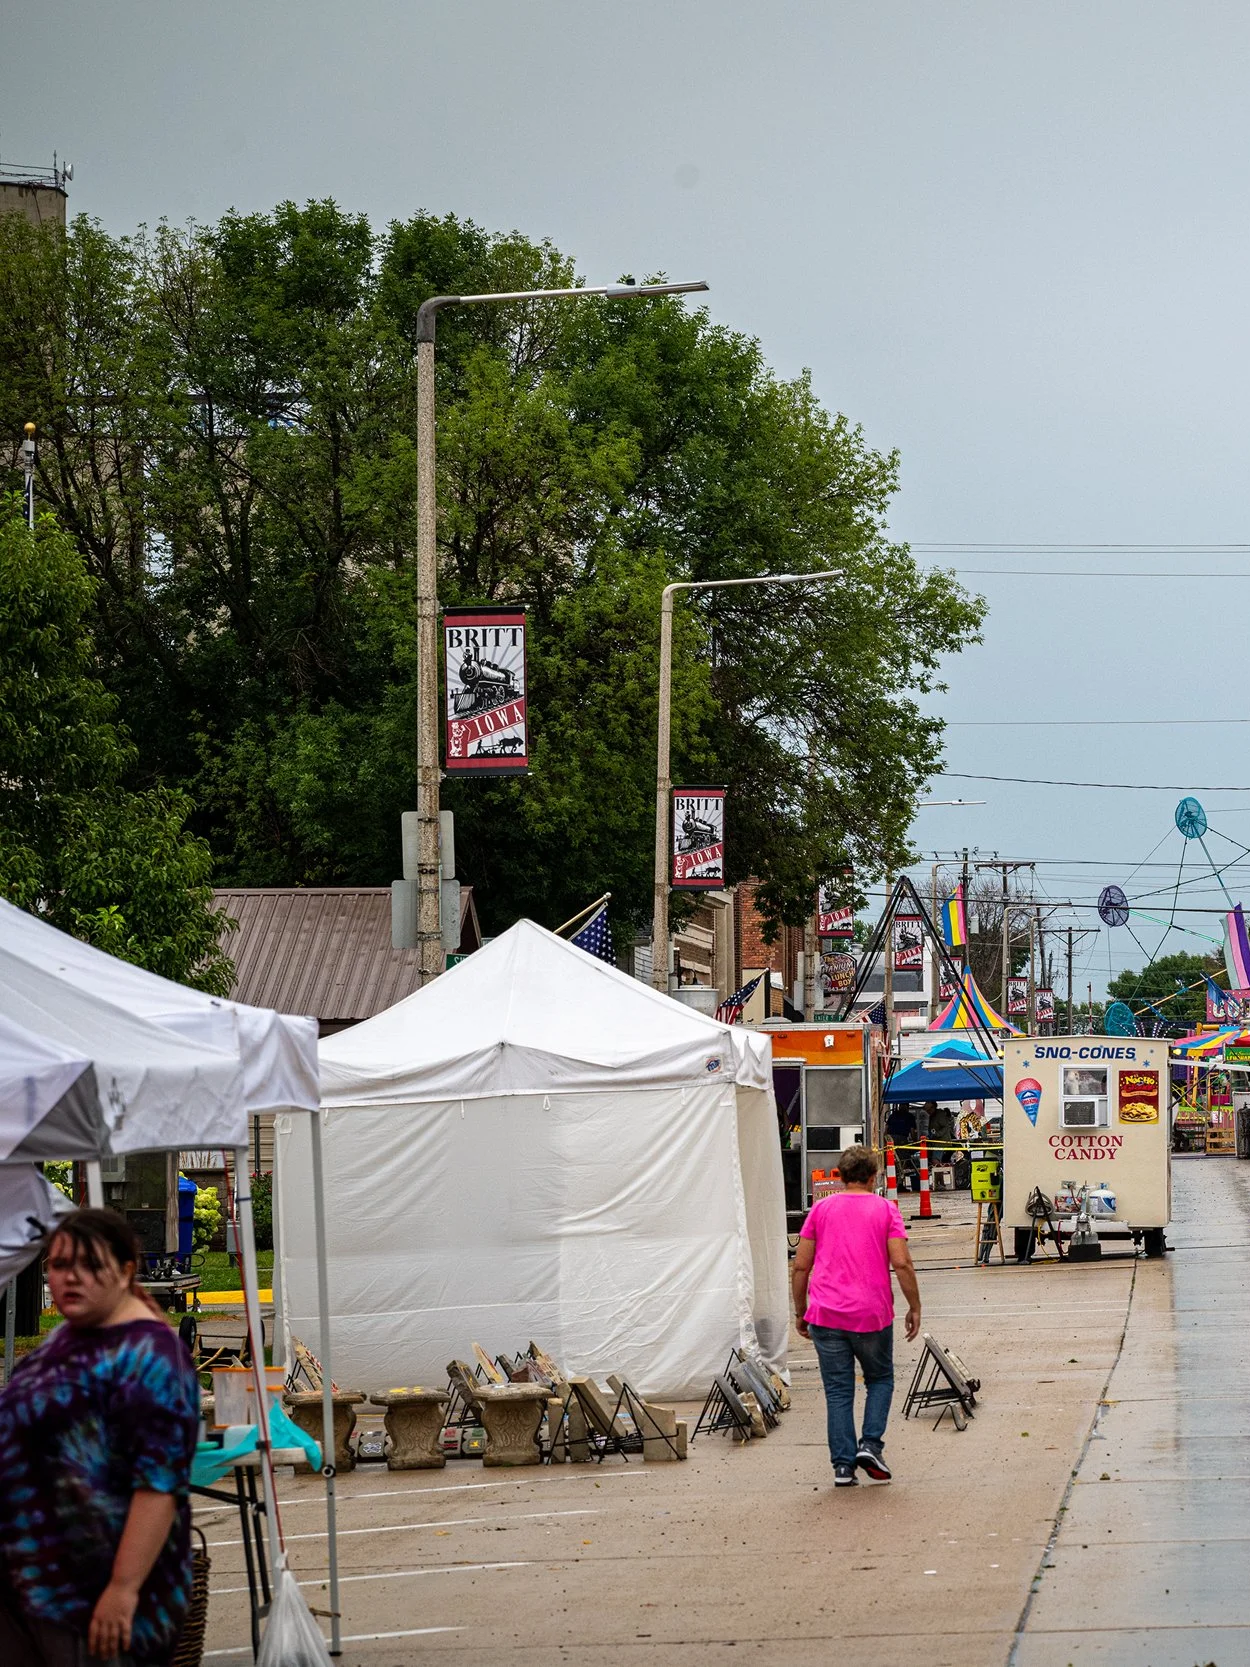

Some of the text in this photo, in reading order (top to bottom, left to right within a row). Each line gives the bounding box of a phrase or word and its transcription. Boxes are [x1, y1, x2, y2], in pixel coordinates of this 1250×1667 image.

[448, 628, 523, 648] BRITT
[474, 704, 524, 736] IOWA
[676, 798, 722, 810] BRITT
[690, 846, 721, 865] IOWA
[831, 969, 855, 981] LUNCH
[1034, 1046, 1136, 1060] SNO-CONES
[1048, 1135, 1124, 1147] COTTON
[1054, 1148, 1118, 1160] CANDY
